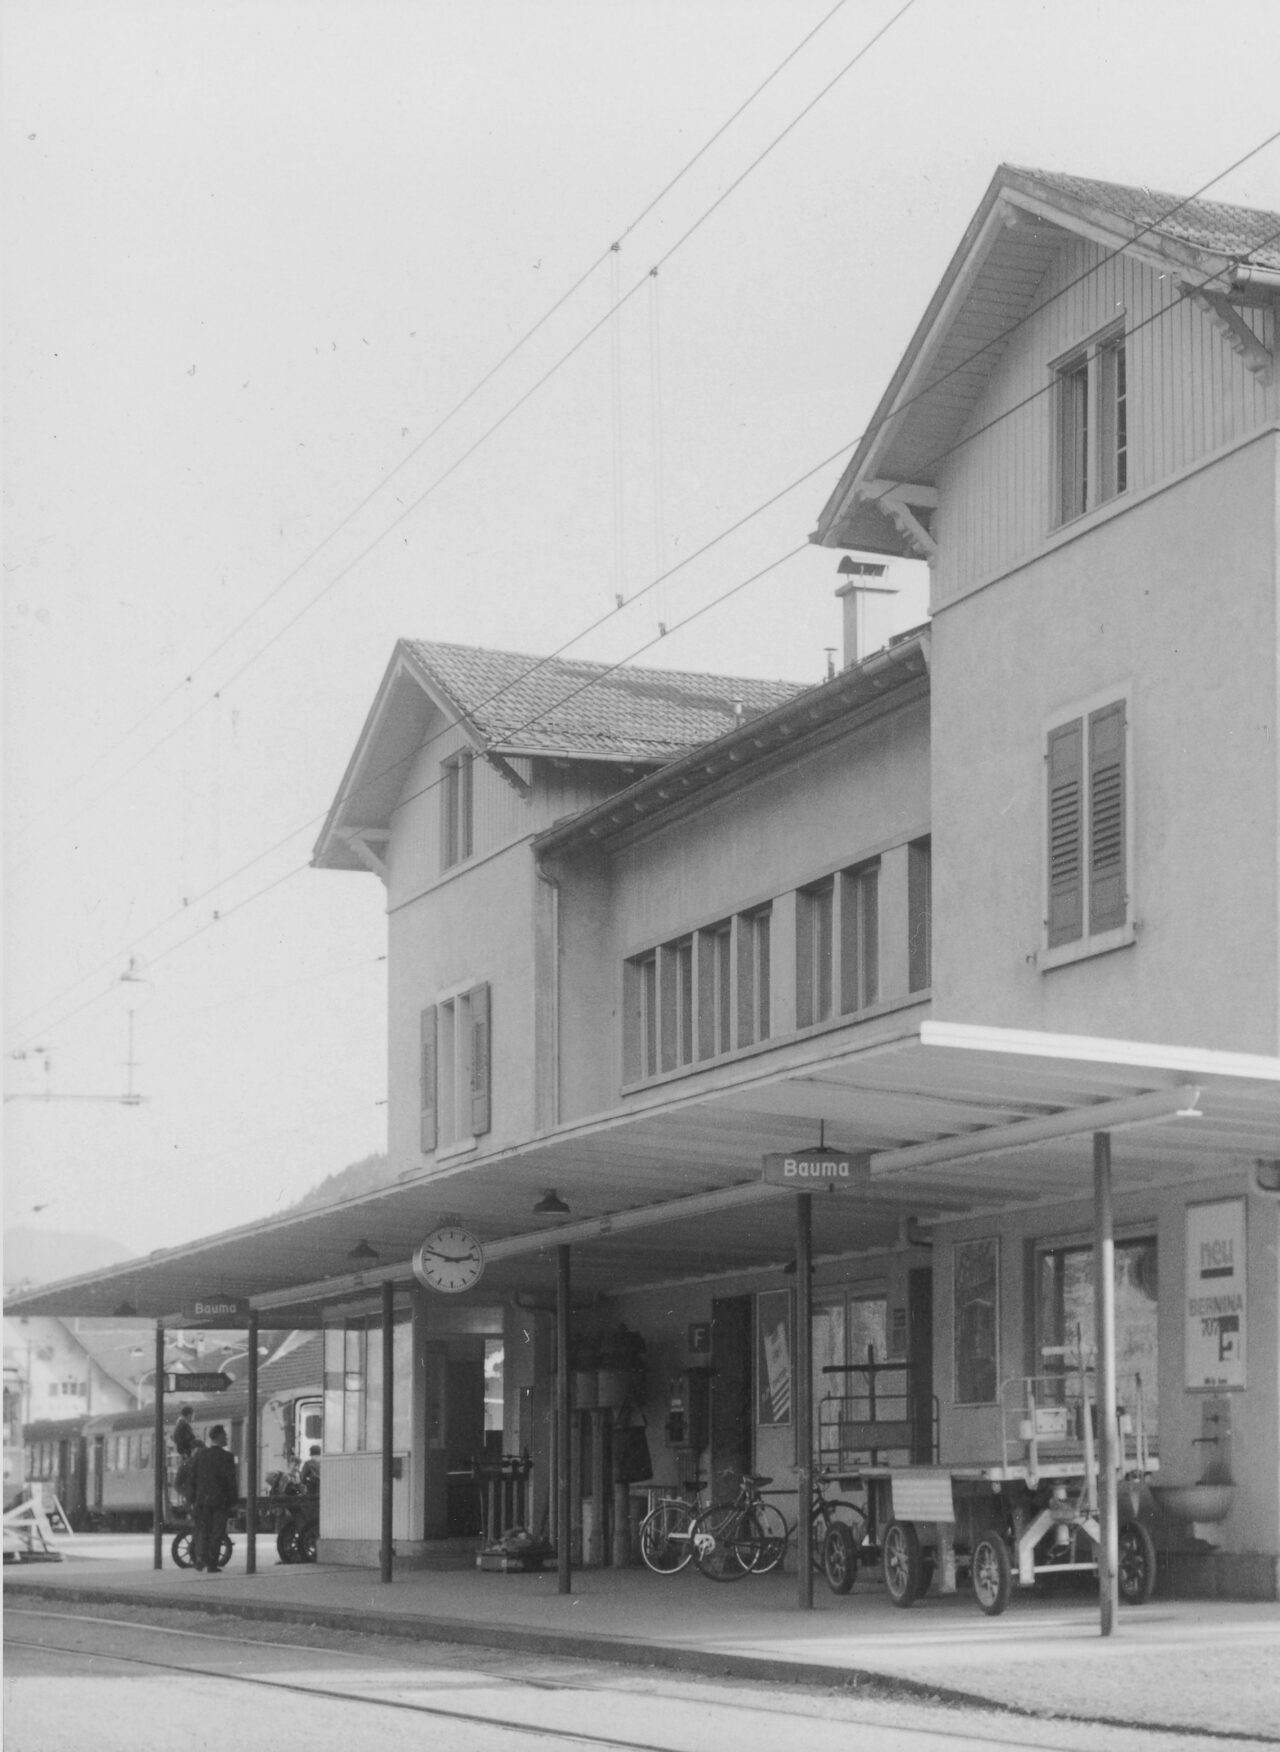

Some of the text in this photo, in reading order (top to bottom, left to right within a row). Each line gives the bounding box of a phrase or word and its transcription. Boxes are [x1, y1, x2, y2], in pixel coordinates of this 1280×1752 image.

[784, 1159, 849, 1176] Bauma
[1200, 1239, 1234, 1266] neu
[195, 1303, 236, 1314] Bauma
[1189, 1294, 1244, 1316] BERNINA
